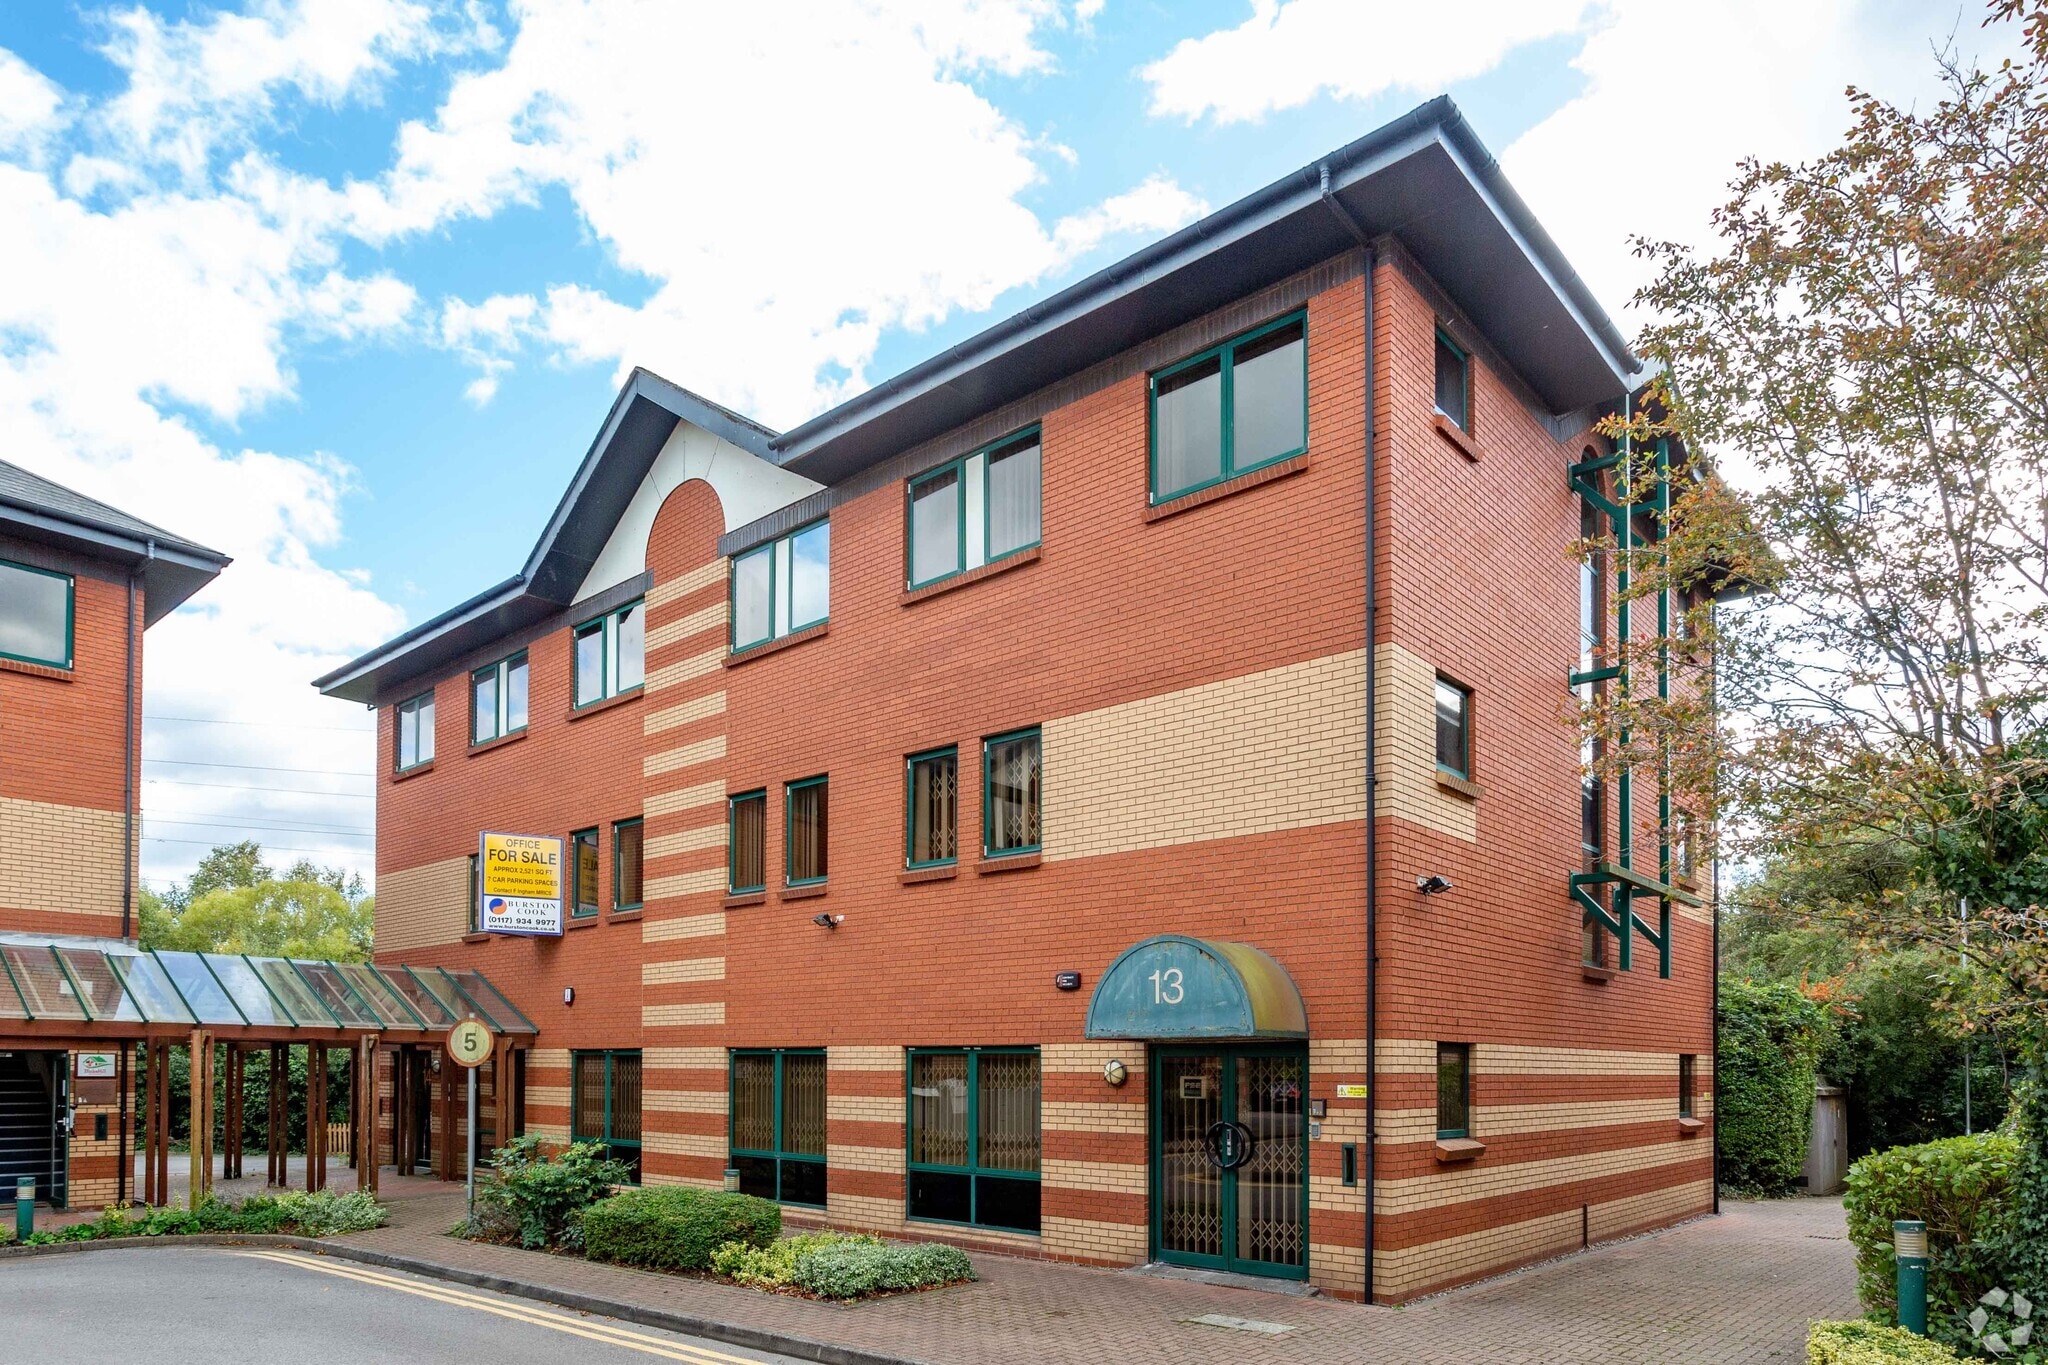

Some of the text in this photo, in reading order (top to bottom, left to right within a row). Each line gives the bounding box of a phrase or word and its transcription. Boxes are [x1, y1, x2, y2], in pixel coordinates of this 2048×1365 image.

[506, 839, 540, 849] OFFICE
[489, 849, 557, 865] FOR SALE
[507, 877, 534, 885] PARKING
[517, 888, 535, 896] Ingham
[508, 900, 556, 909] BURSTON
[488, 916, 513, 924] (0117)
[1149, 968, 1184, 1004] 13
[464, 1033, 477, 1051] 5
